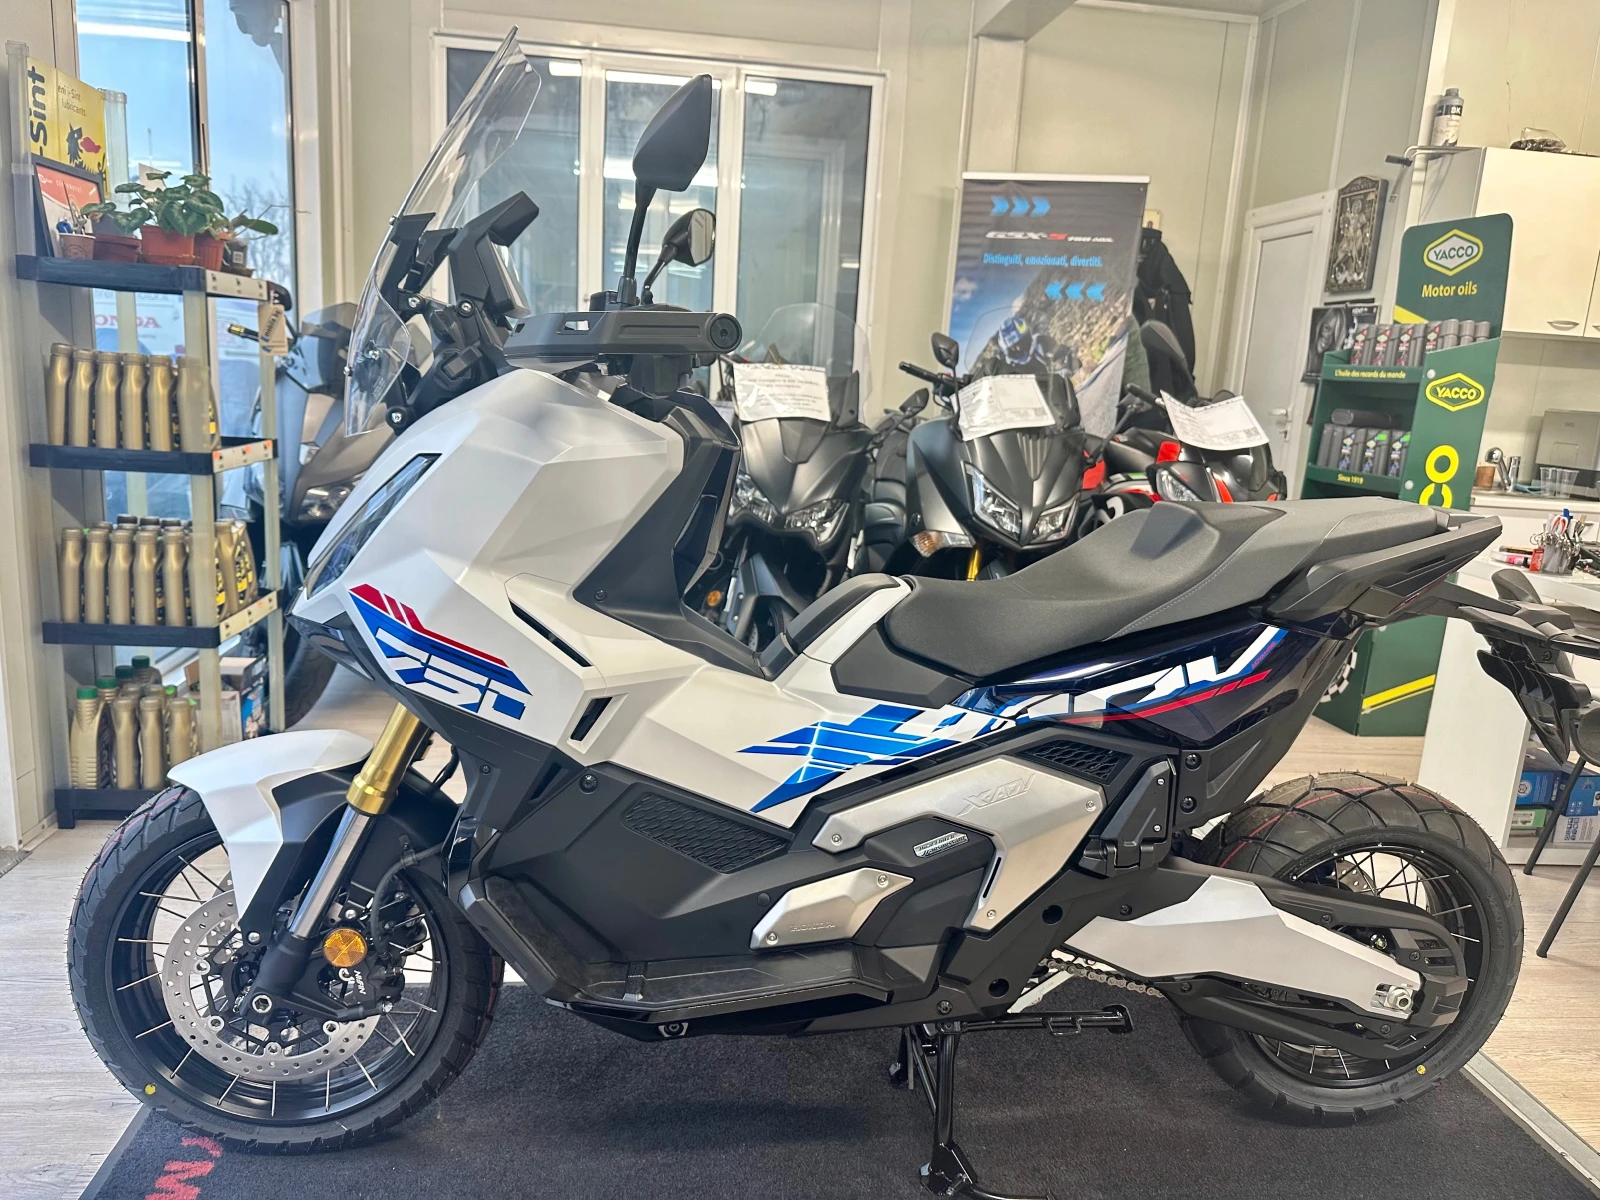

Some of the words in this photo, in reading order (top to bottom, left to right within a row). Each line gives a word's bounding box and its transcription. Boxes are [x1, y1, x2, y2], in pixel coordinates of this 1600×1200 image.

[61, 99, 87, 117] lubricants
[1433, 245, 1474, 261] YACCO
[1421, 284, 1456, 298] Motor
[1457, 281, 1478, 296] oils
[1379, 371, 1386, 379] du
[1387, 371, 1406, 380] monde
[1436, 386, 1477, 400] YACCO
[1337, 473, 1350, 483] Since
[375, 626, 530, 727] 750
[954, 771, 1036, 817] X-ADV
